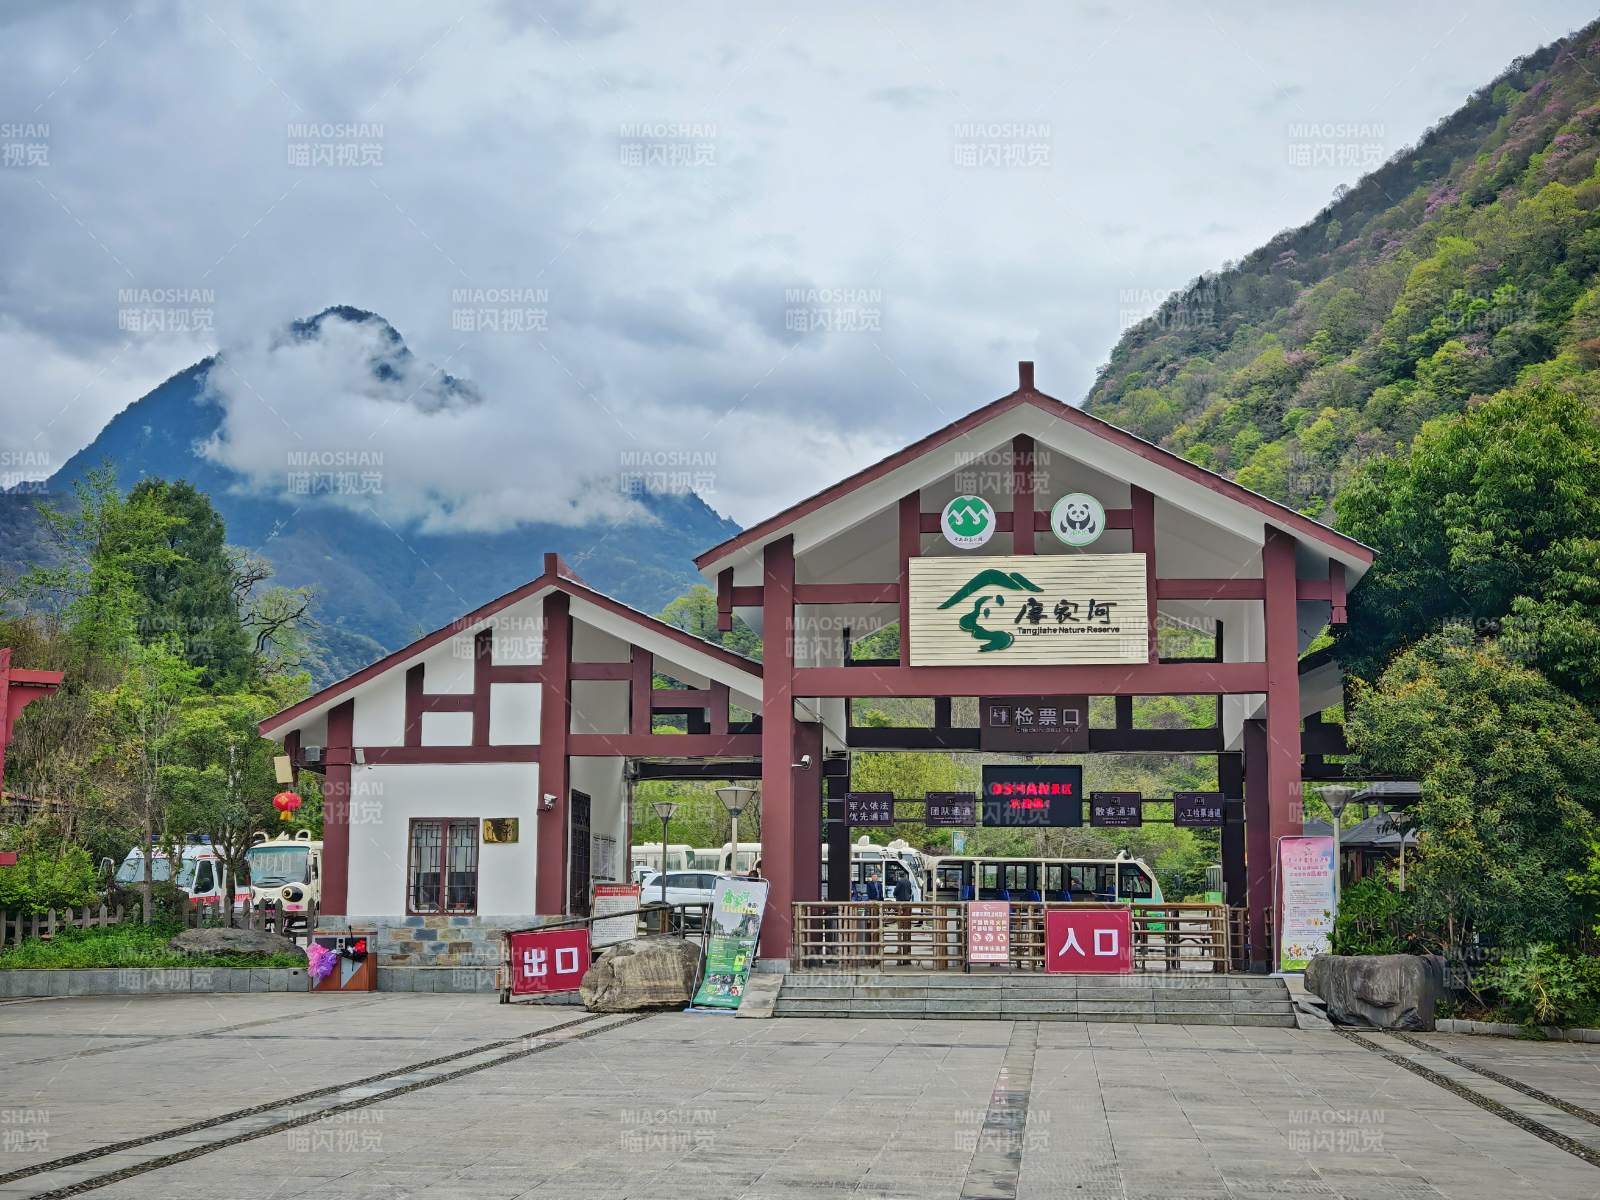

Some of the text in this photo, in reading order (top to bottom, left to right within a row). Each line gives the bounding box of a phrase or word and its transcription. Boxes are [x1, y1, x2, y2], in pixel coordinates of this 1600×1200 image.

[1017, 627, 1057, 635] Tangjiahe
[1015, 707, 1080, 726] 检票口
[848, 801, 890, 811] 军人依法
[930, 806, 971, 816] 团队通道
[1095, 806, 1137, 817] 散客通道
[848, 811, 890, 821] 优先通道
[1179, 807, 1222, 818] 人工检票通道
[1058, 927, 1119, 957] 入口
[523, 946, 579, 977] 出口
